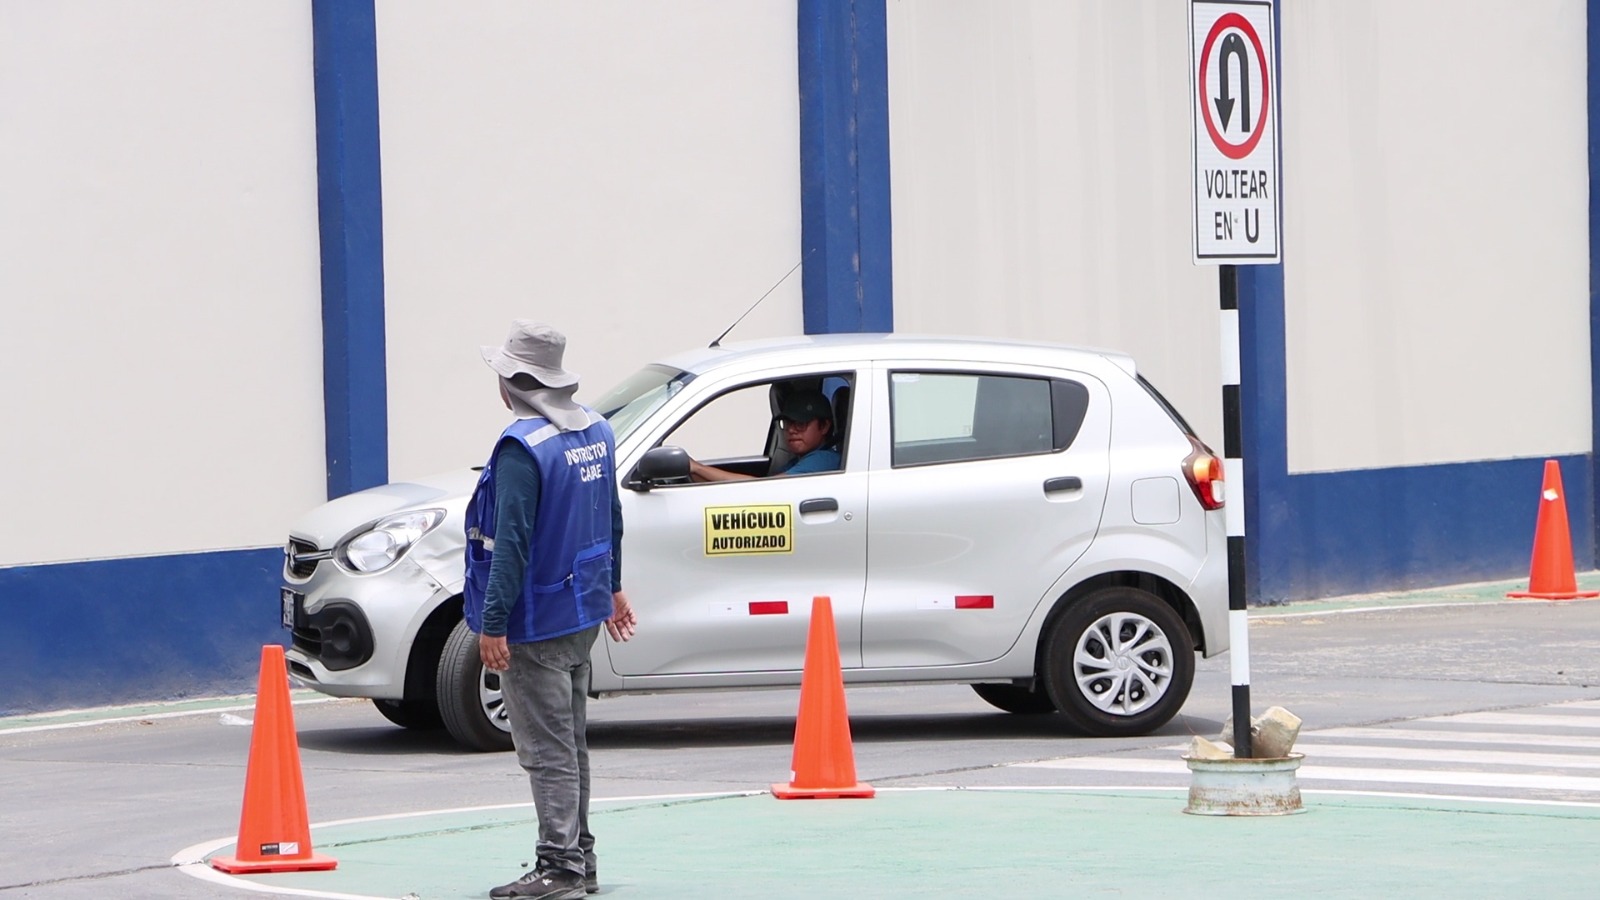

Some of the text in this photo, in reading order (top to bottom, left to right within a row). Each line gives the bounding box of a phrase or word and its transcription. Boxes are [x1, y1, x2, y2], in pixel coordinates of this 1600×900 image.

[1205, 169, 1268, 199] VOLTEAR
[1215, 208, 1259, 244] EN U
[711, 509, 786, 530] VEHÍCULO
[712, 535, 786, 550] AUTORIZADO
